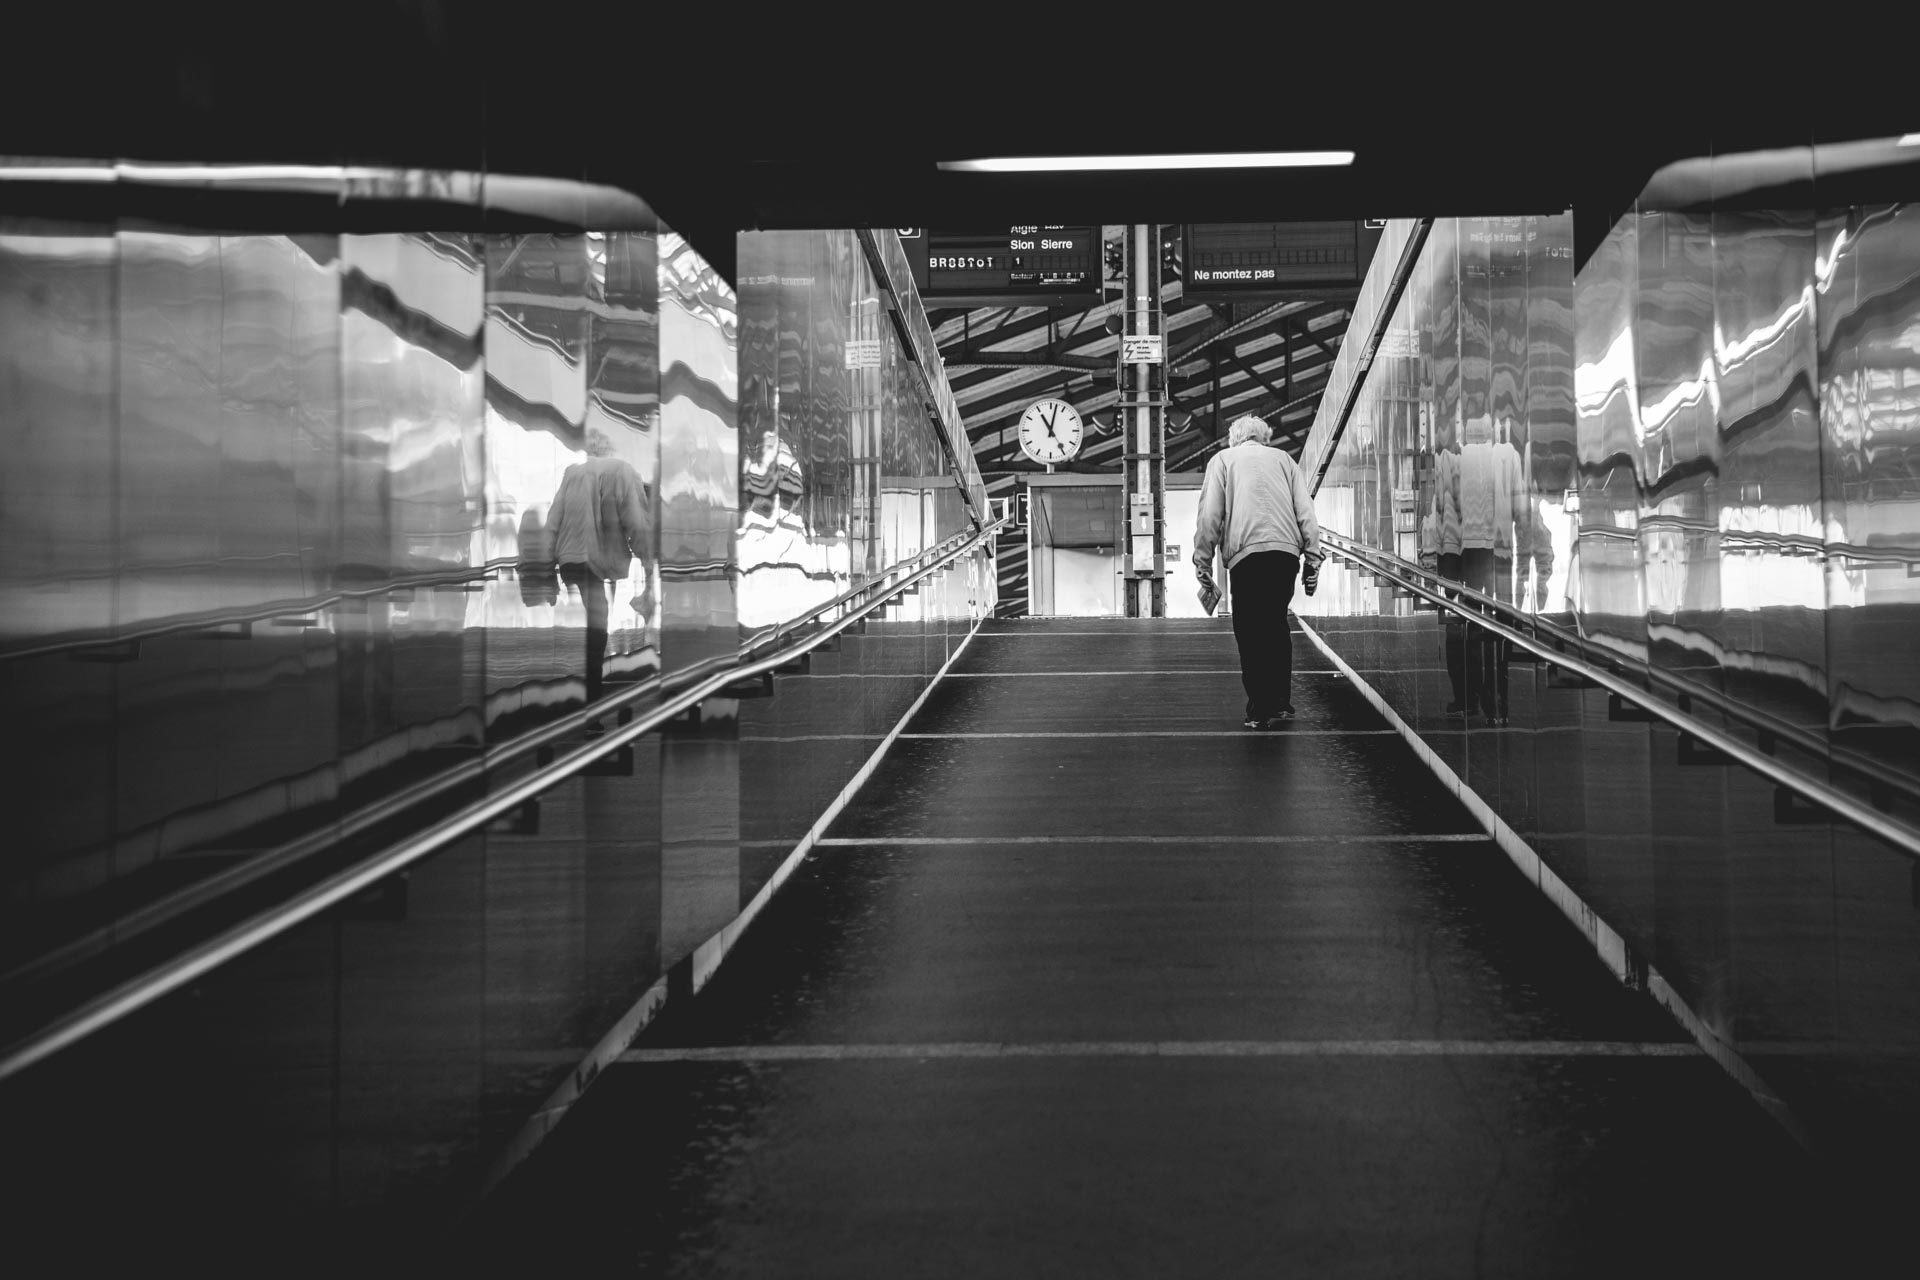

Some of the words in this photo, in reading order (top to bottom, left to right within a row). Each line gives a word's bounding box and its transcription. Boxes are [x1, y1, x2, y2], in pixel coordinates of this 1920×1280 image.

[1010, 239, 1035, 250] Sion
[1041, 239, 1073, 250] Sierre
[1194, 270, 1210, 281] Ne
[1212, 269, 1252, 280] montez
[1254, 269, 1275, 281] pas
